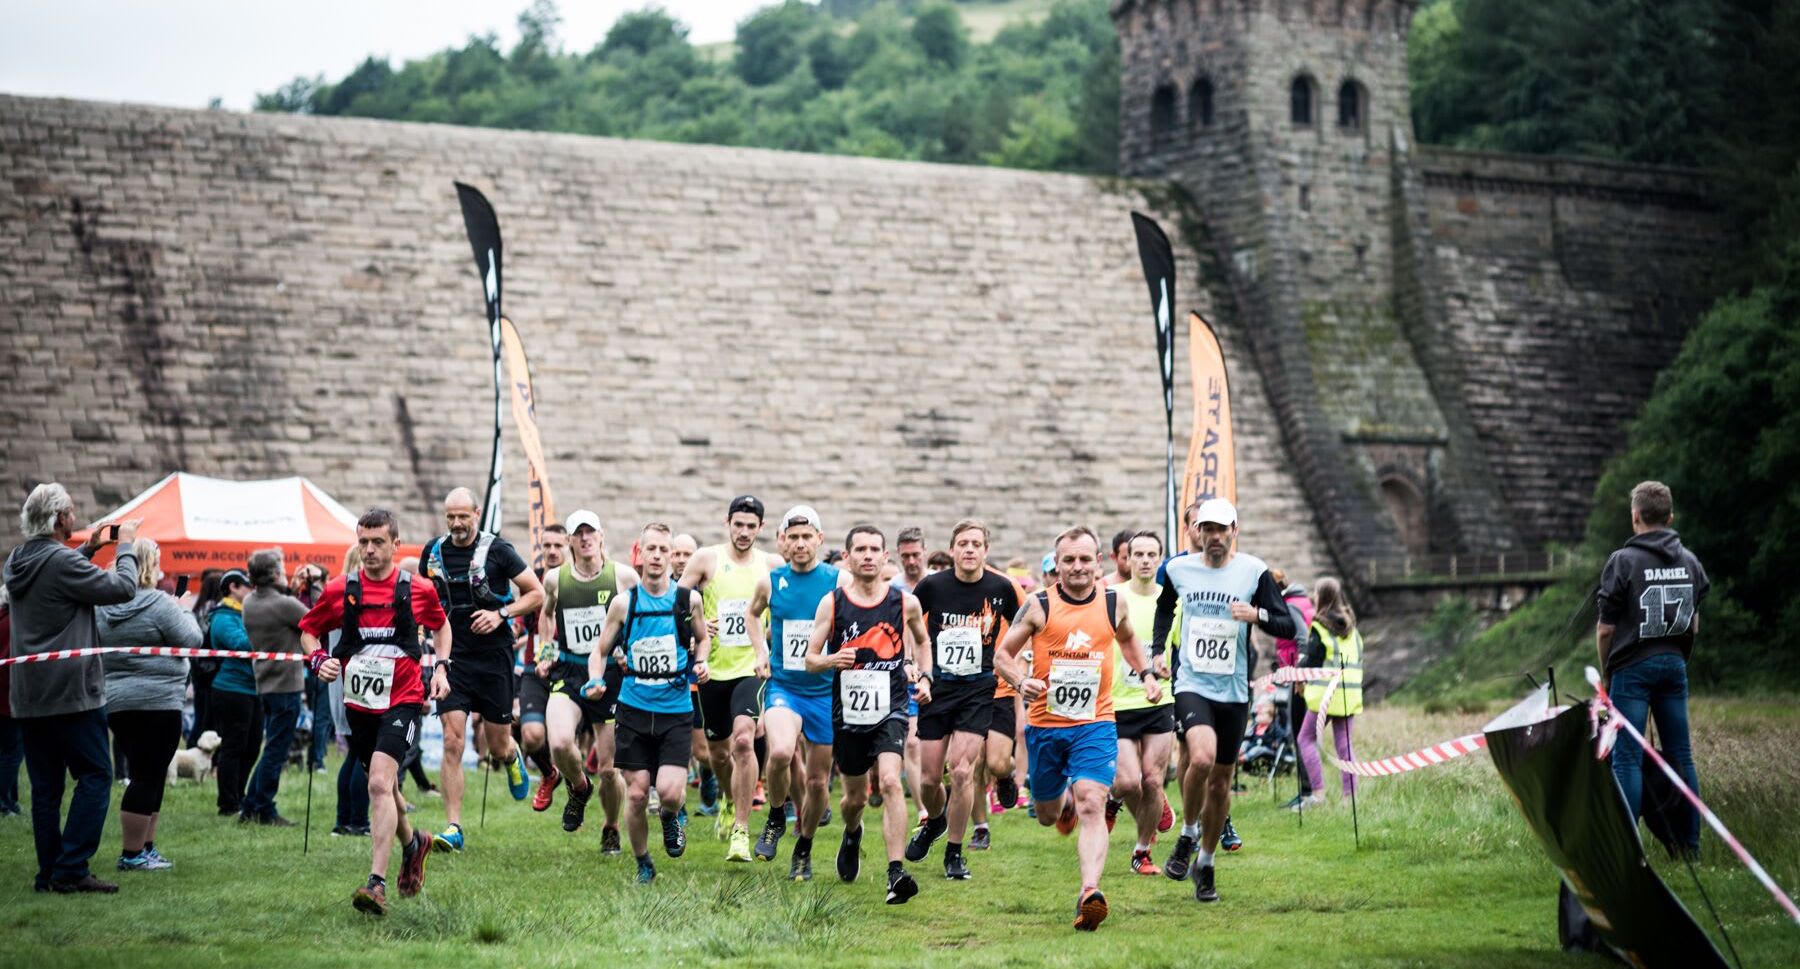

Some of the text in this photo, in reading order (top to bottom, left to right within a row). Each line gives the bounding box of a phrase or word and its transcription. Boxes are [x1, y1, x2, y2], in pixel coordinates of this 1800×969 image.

[1644, 567, 1689, 581] DANIEL
[1639, 583, 1695, 639] 17
[574, 622, 601, 643] 104
[945, 645, 976, 665] 274
[1195, 638, 1230, 661] 086
[639, 654, 670, 674] 083
[351, 674, 385, 696] 070
[849, 690, 879, 711] 221
[1055, 685, 1092, 708] 099
